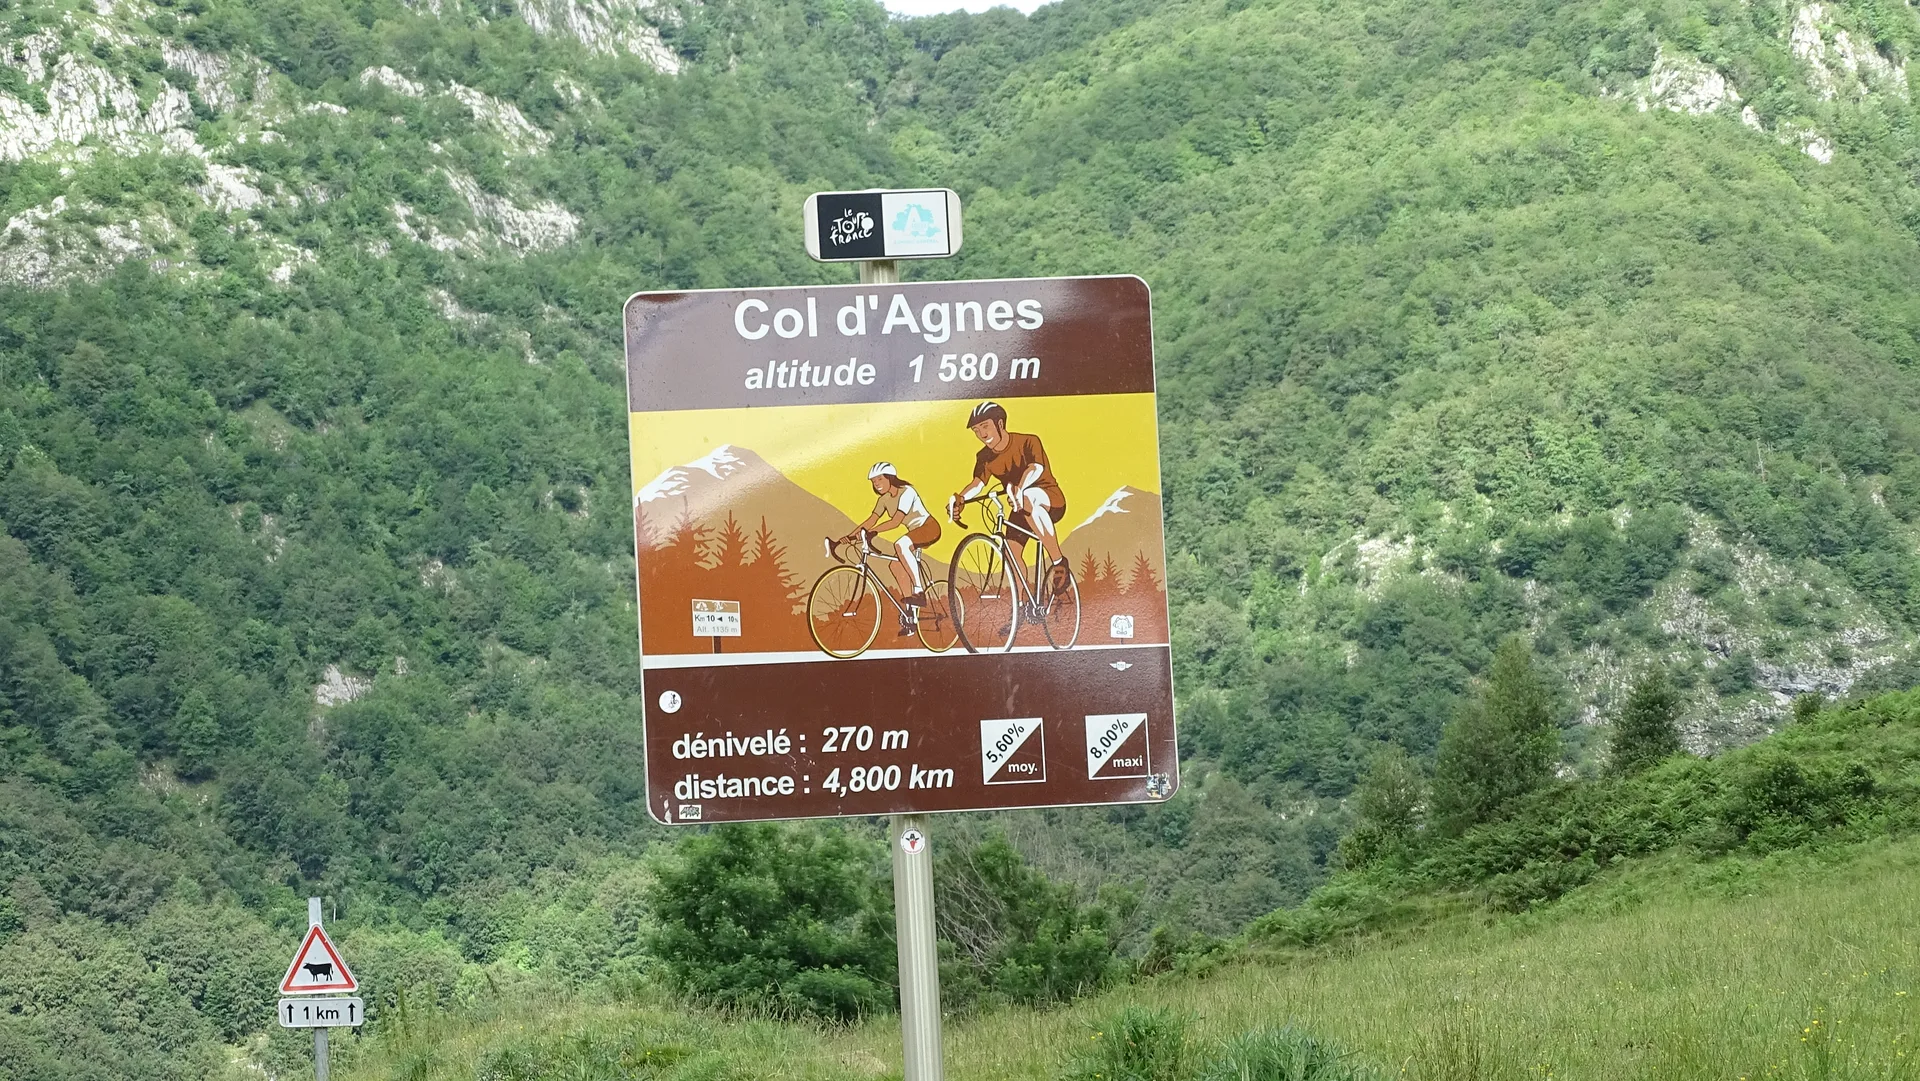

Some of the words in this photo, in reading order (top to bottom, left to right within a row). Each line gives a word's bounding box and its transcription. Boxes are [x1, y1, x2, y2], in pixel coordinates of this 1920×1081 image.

[734, 298, 818, 341] Col
[837, 293, 1045, 345] d'Agnes
[744, 357, 877, 391] altitude
[908, 354, 925, 383] 1
[938, 352, 999, 383] 580
[1009, 354, 1041, 380] m
[695, 614, 705, 622] Km
[707, 614, 716, 622] 10
[672, 728, 791, 760] dénivelé
[822, 725, 874, 753] 270
[881, 728, 909, 750] m
[986, 722, 1025, 764] 5,60%
[1090, 718, 1129, 760] 8,00%
[1008, 762, 1038, 775] moy.
[1113, 755, 1143, 768] maxi
[674, 773, 795, 801] distance
[822, 765, 901, 797] 4,800
[908, 763, 954, 790] km
[303, 1006, 310, 1020] 1
[316, 1006, 339, 1020] km
